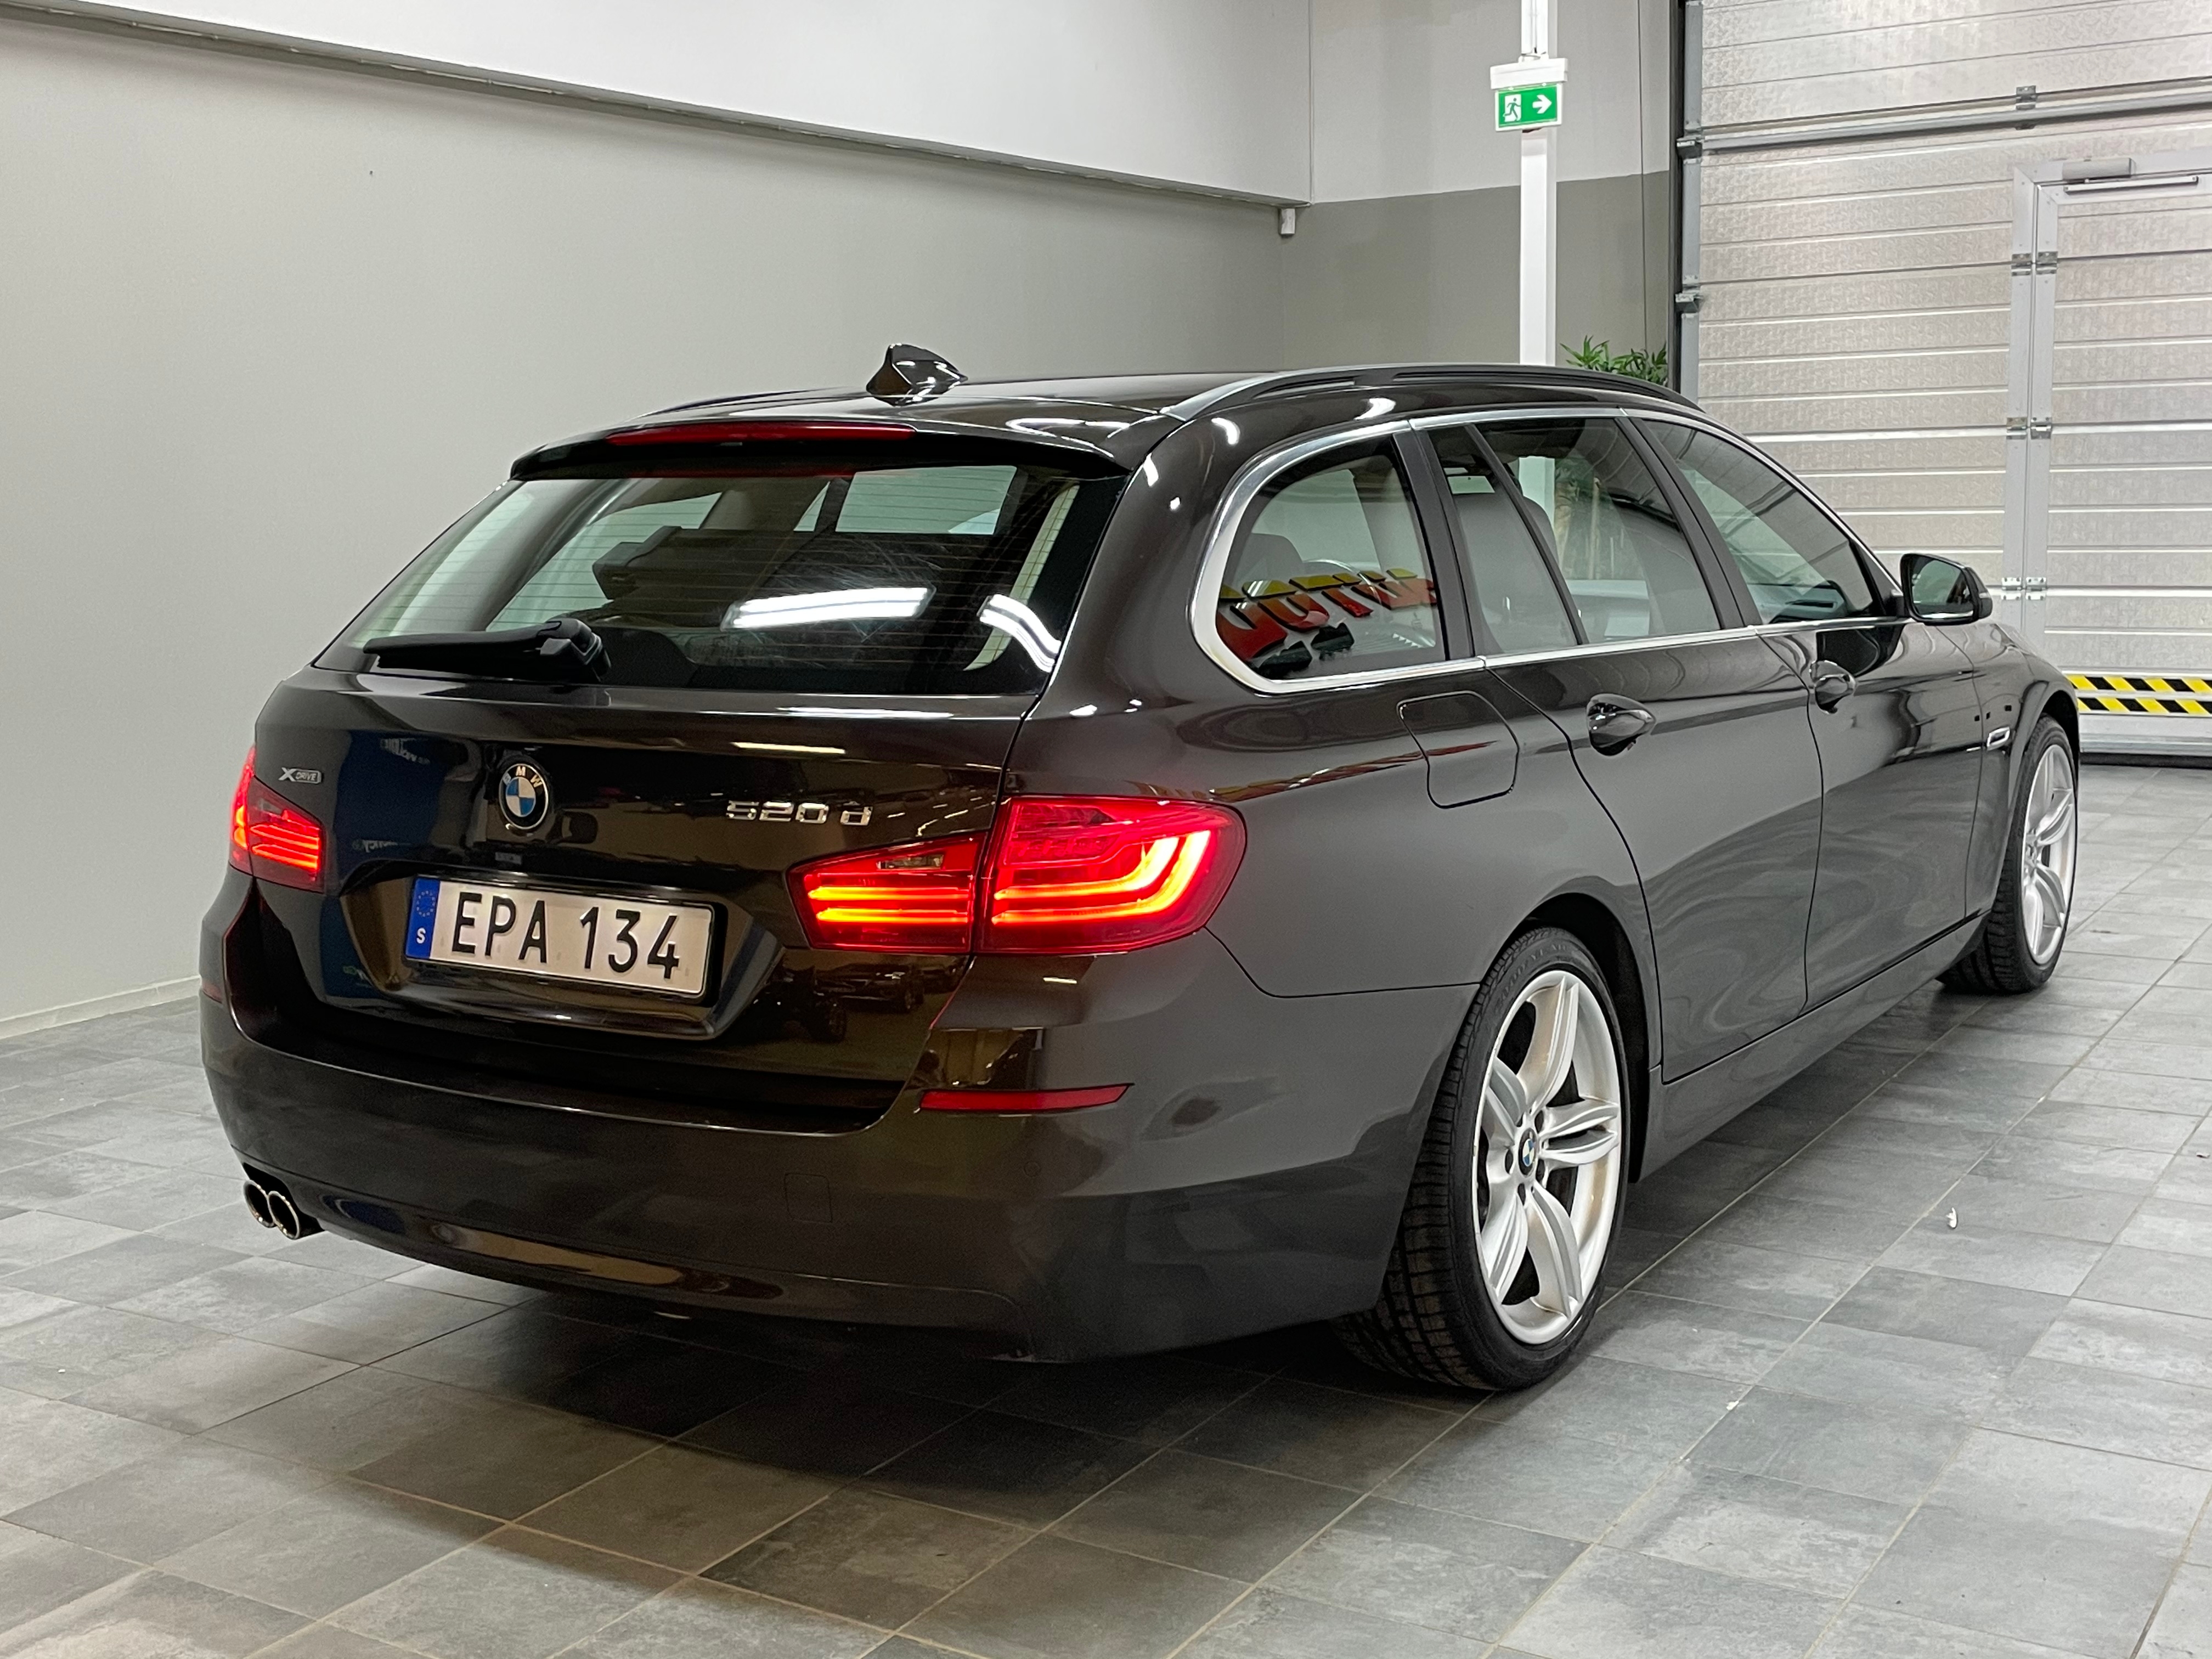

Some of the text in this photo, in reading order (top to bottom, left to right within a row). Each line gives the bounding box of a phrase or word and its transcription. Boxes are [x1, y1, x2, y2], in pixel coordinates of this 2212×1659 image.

[726, 800, 829, 823] 520
[416, 927, 426, 944] S
[452, 891, 680, 979] EPA 134
